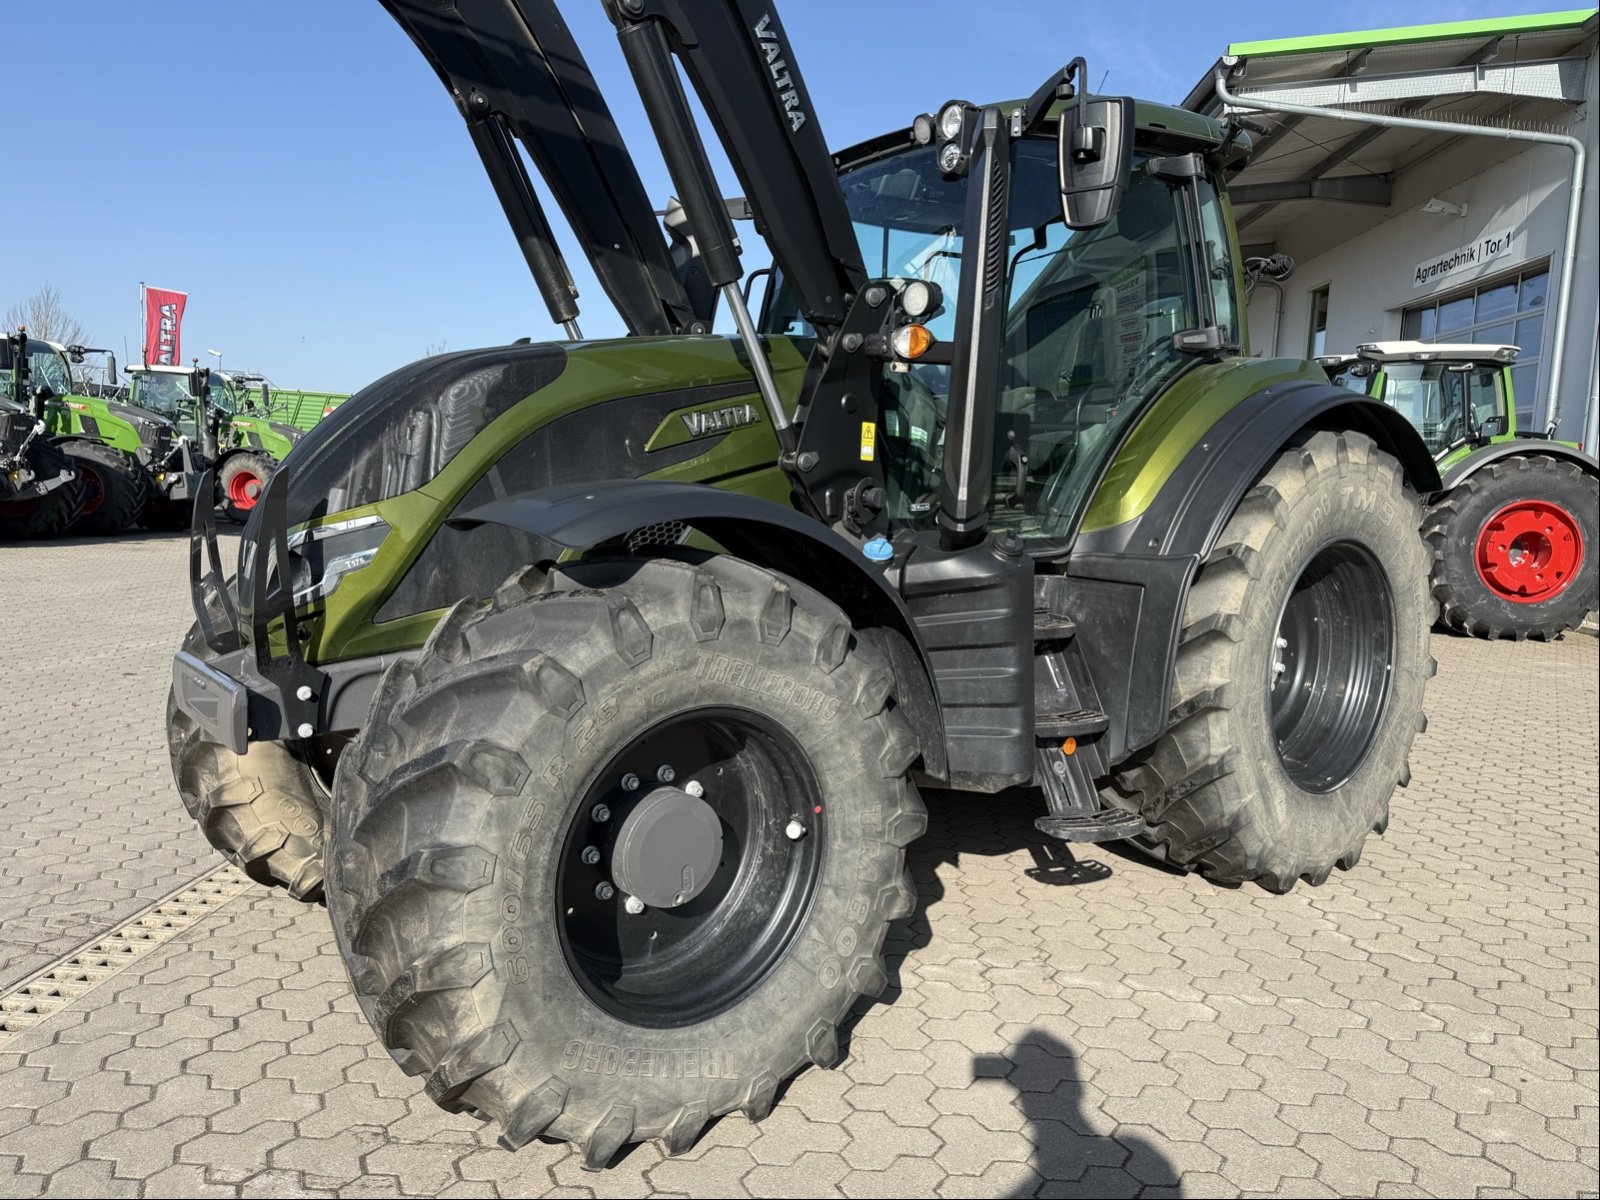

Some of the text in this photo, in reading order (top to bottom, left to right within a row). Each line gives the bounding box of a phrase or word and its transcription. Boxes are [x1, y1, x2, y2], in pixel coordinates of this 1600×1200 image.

[754, 12, 807, 132] VALTRA
[1415, 247, 1475, 283] Agrartechnik
[1485, 239, 1502, 256] Tor
[1505, 231, 1511, 248] 1
[159, 303, 177, 365] ALTRA
[682, 403, 761, 436] VALTRA
[695, 650, 841, 721] TRELLEBORG
[502, 797, 546, 986] 600/65
[560, 1039, 740, 1080] TRELLEBORG
